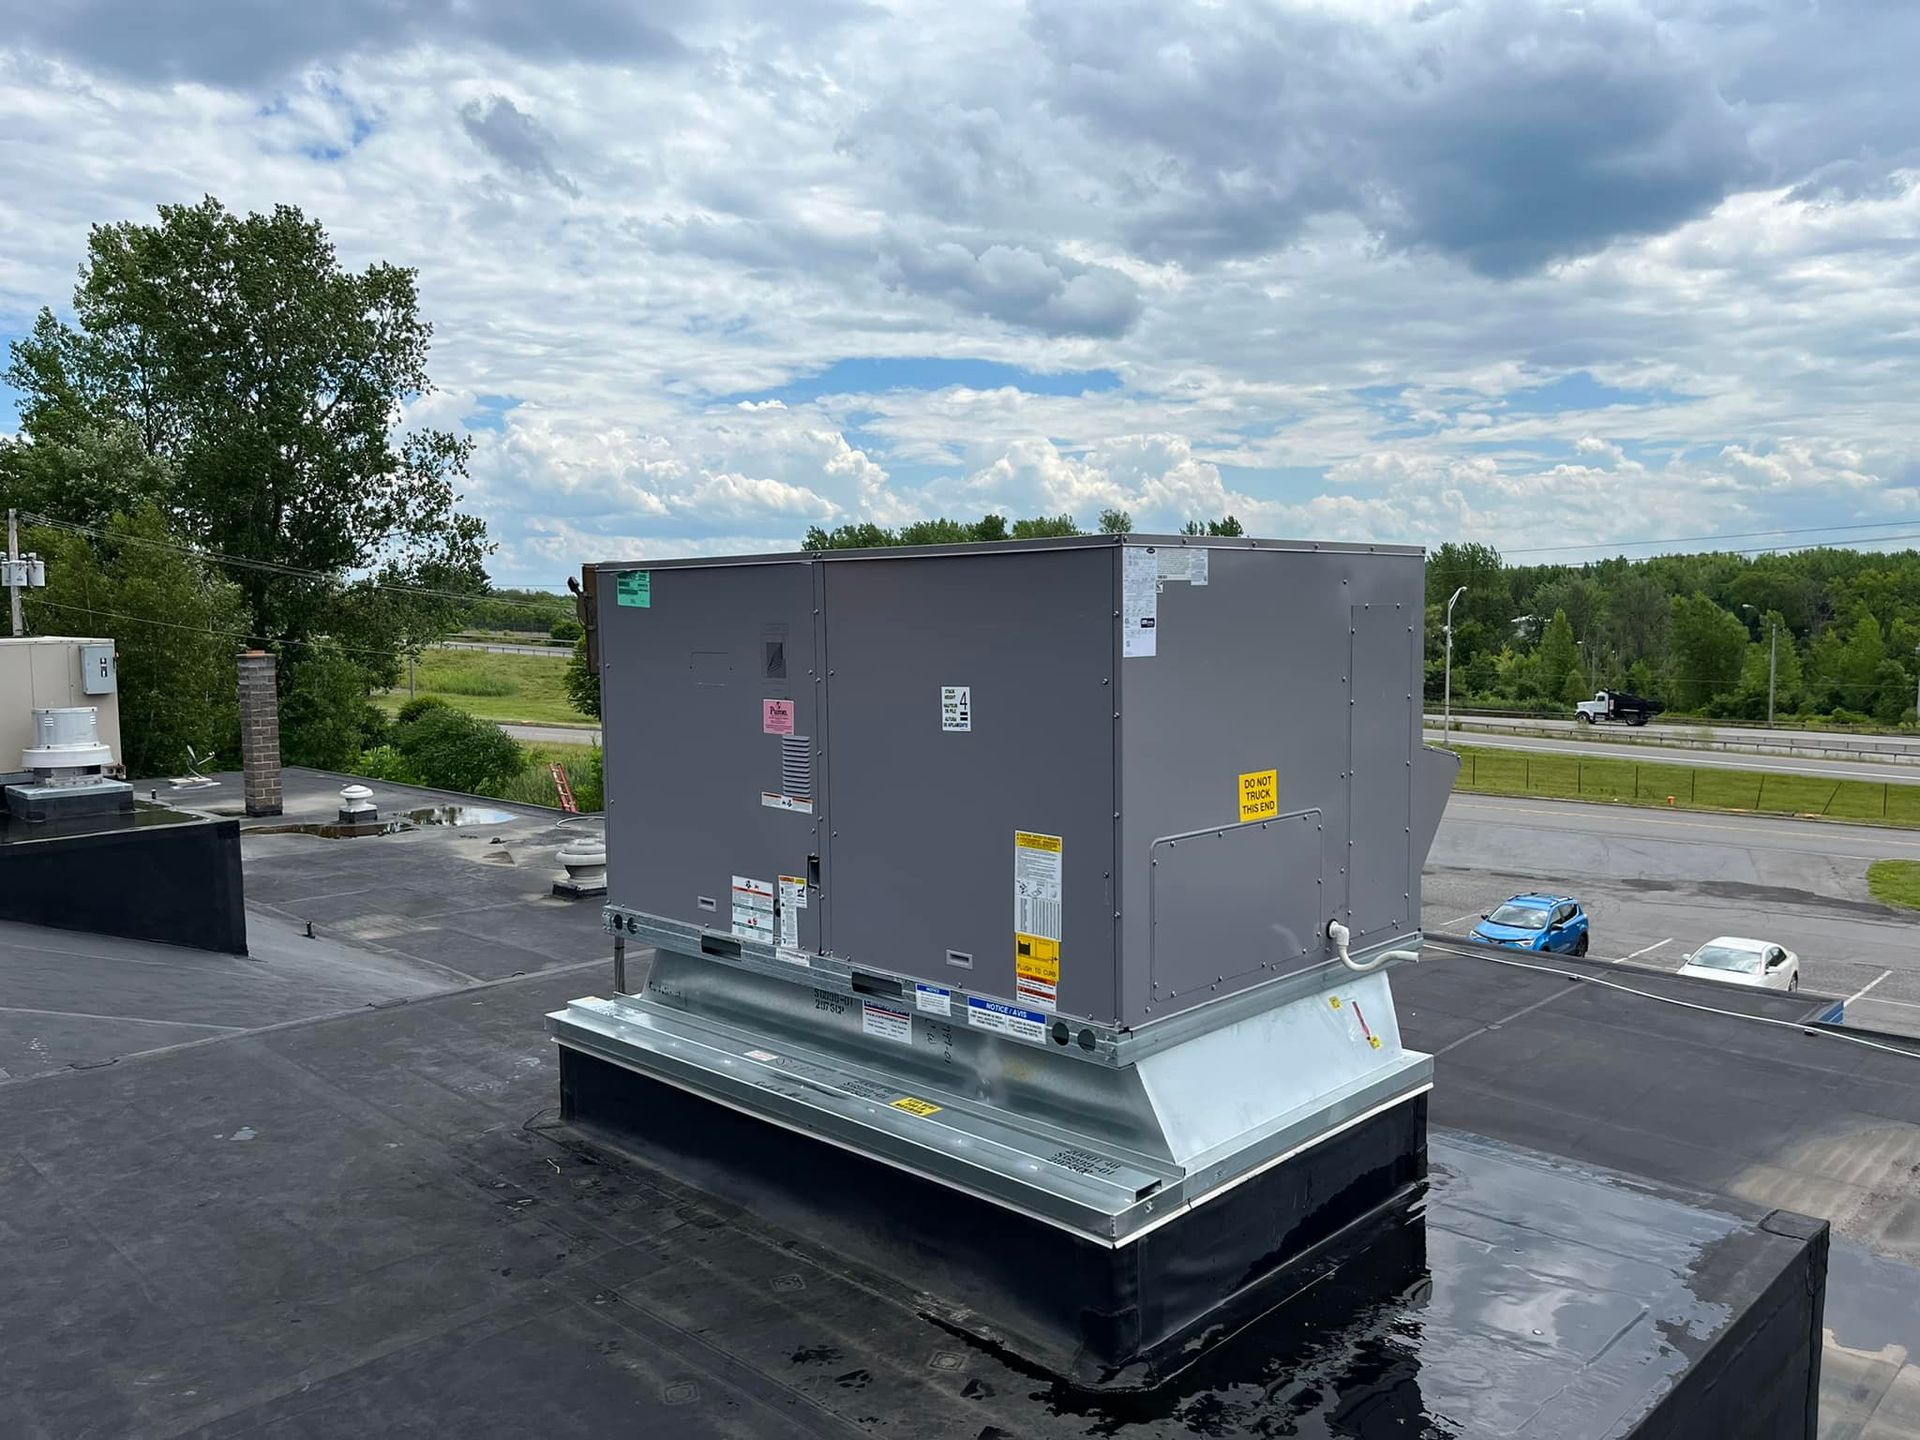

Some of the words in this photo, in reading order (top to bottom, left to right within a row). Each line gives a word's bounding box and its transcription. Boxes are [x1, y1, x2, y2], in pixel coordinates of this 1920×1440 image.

[960, 691, 968, 711] 4
[1245, 779, 1255, 789] DO
[1257, 776, 1272, 786] NOT
[1246, 789, 1271, 801] TRUCK
[1243, 803, 1259, 814] THIS
[1260, 801, 1275, 811] END
[1034, 967, 1042, 975] TO
[985, 1002, 1009, 1014] NOTICE
[1012, 1008, 1028, 1018] AVIS
